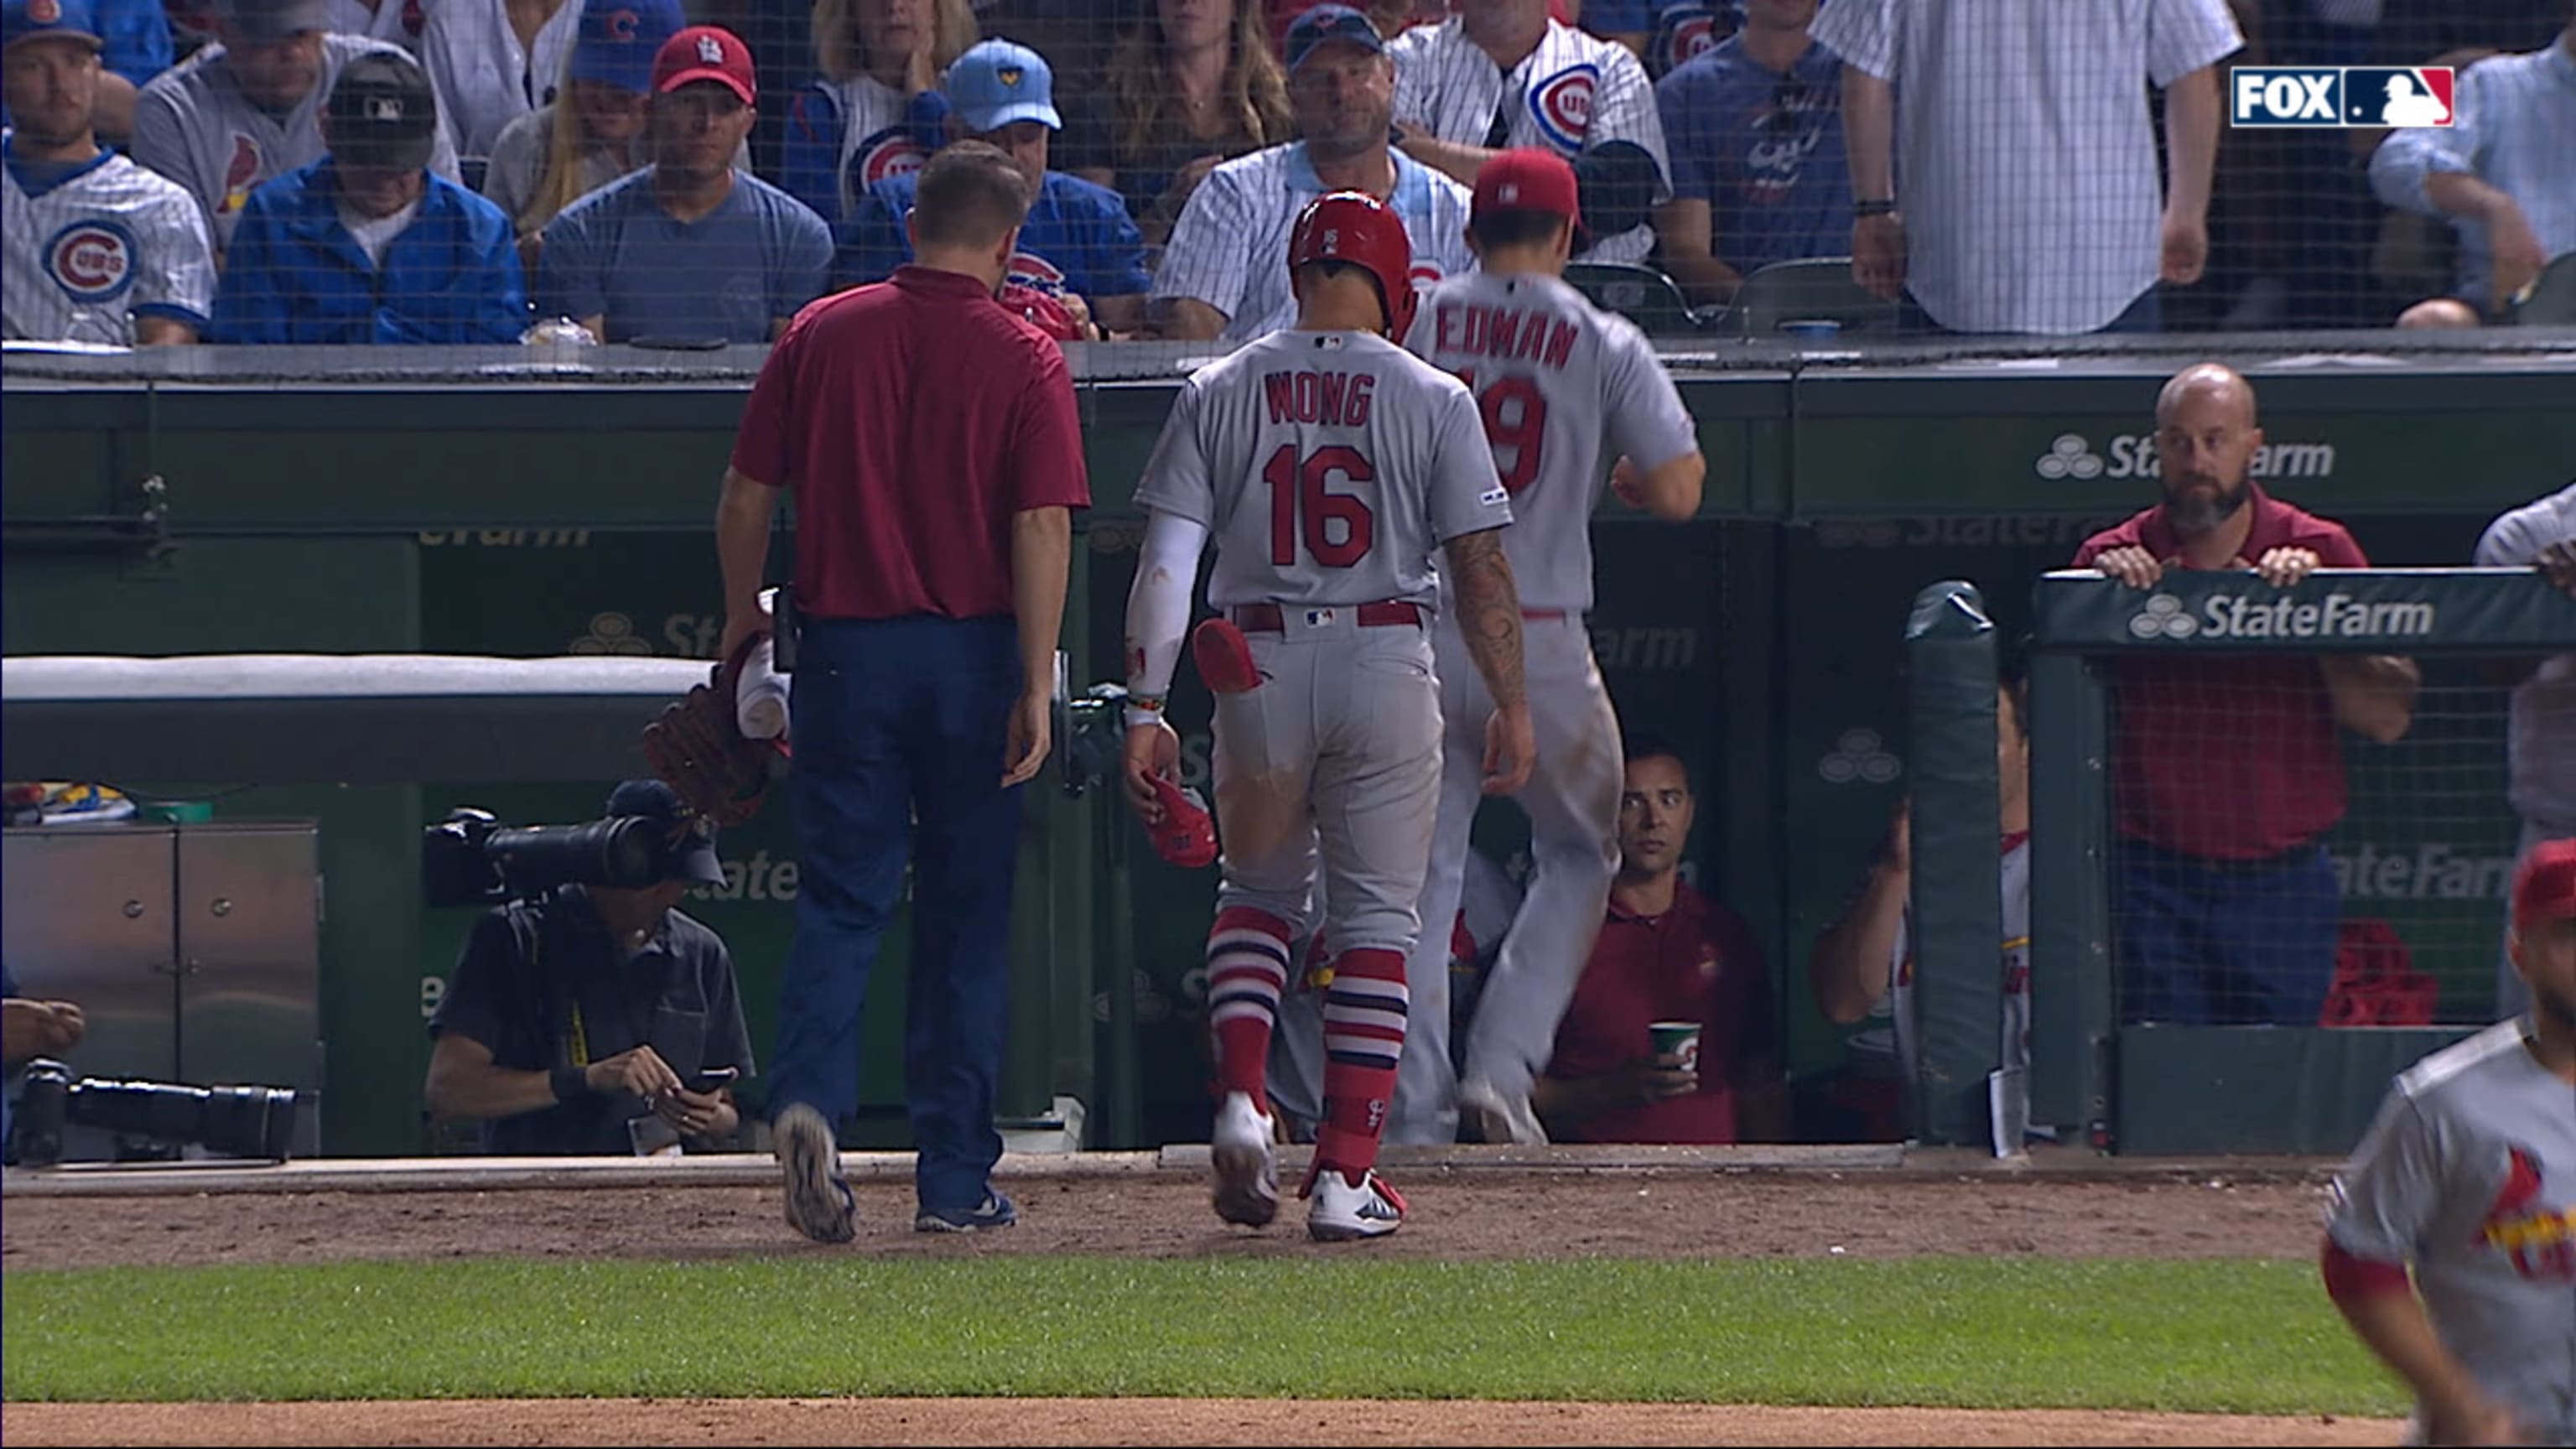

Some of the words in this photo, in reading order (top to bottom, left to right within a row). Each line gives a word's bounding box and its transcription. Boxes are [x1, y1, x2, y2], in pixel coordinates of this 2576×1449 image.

[1436, 302, 1579, 371] EDMAN
[1265, 371, 1375, 427] WONG
[1263, 443, 1374, 568] 16
